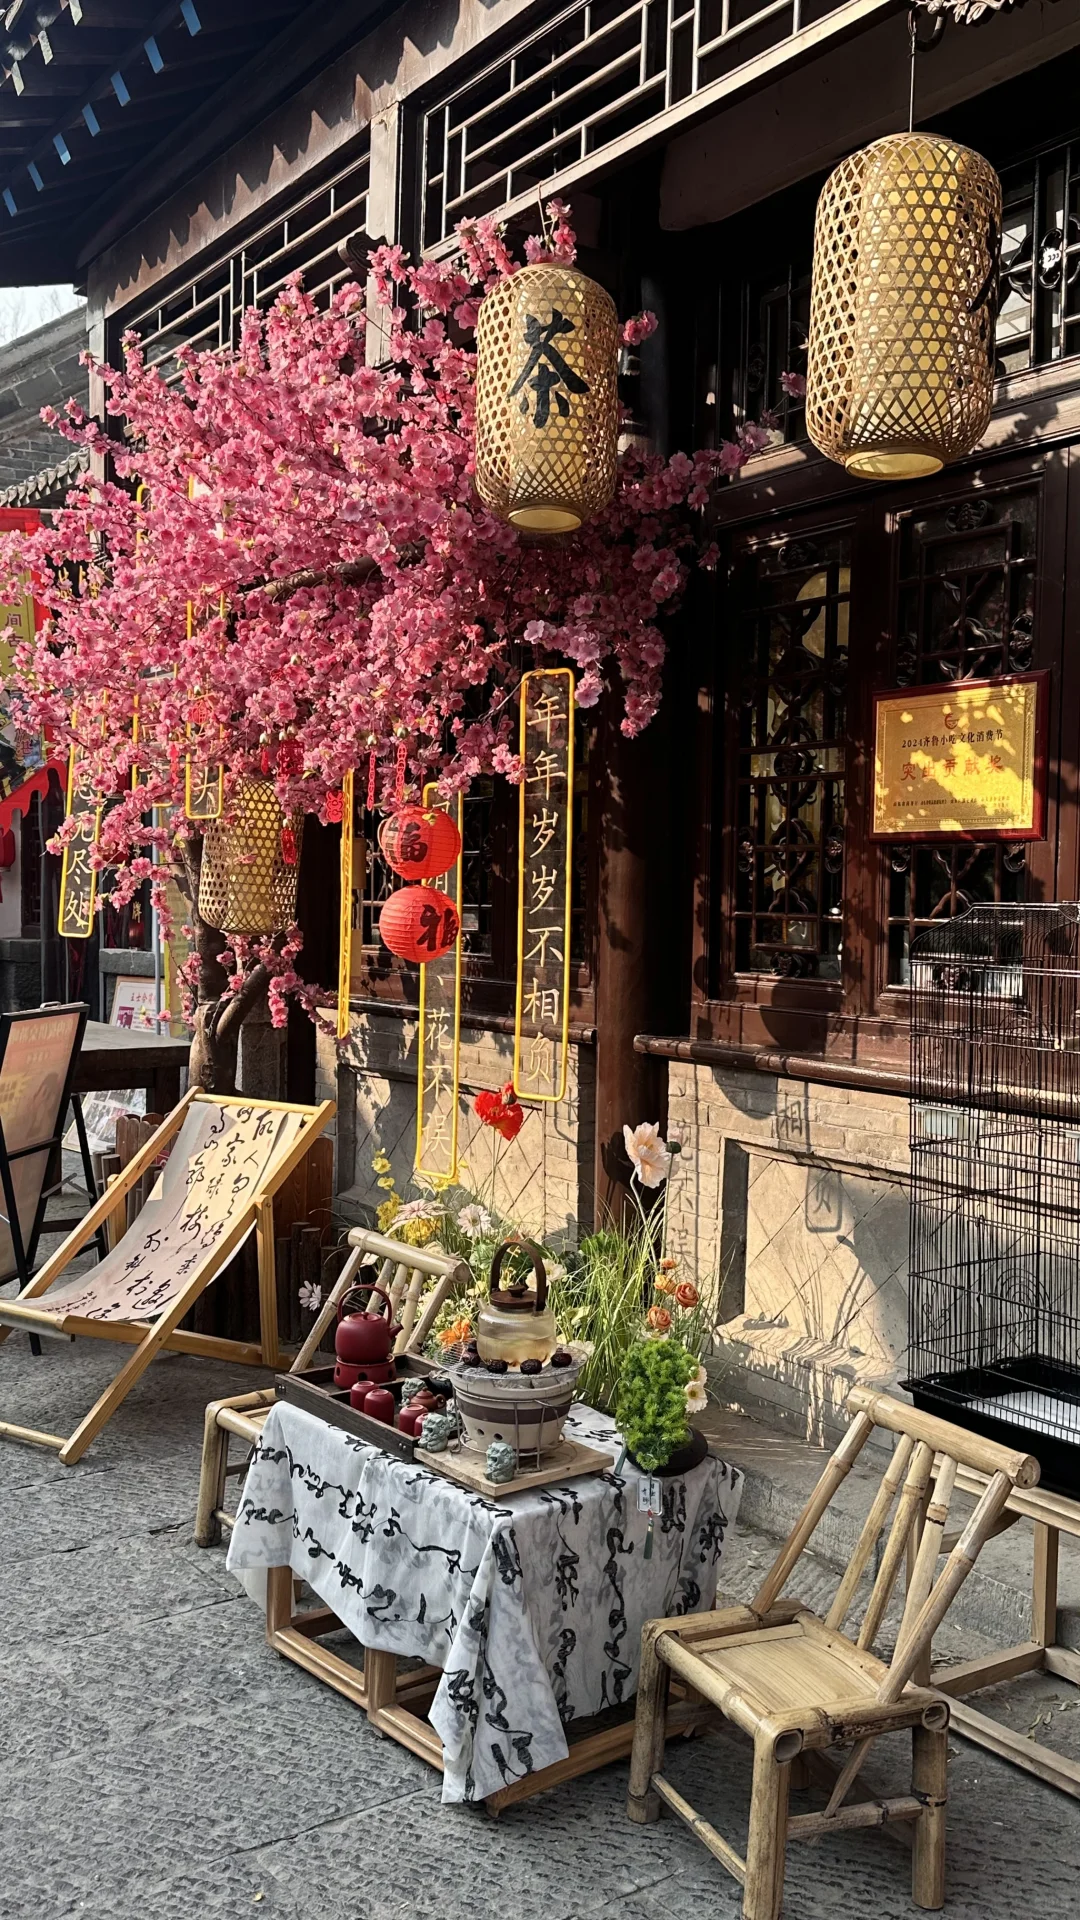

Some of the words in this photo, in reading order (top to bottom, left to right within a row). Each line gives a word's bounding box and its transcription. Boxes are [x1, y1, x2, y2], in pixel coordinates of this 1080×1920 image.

[507, 308, 591, 429] 茶
[901, 728, 1004, 749] 2024齐鲁小吃文化消费节
[900, 754, 1004, 782] 突出贡献奖
[524, 691, 568, 1085] 年年岁岁不相负
[416, 903, 460, 952] 福
